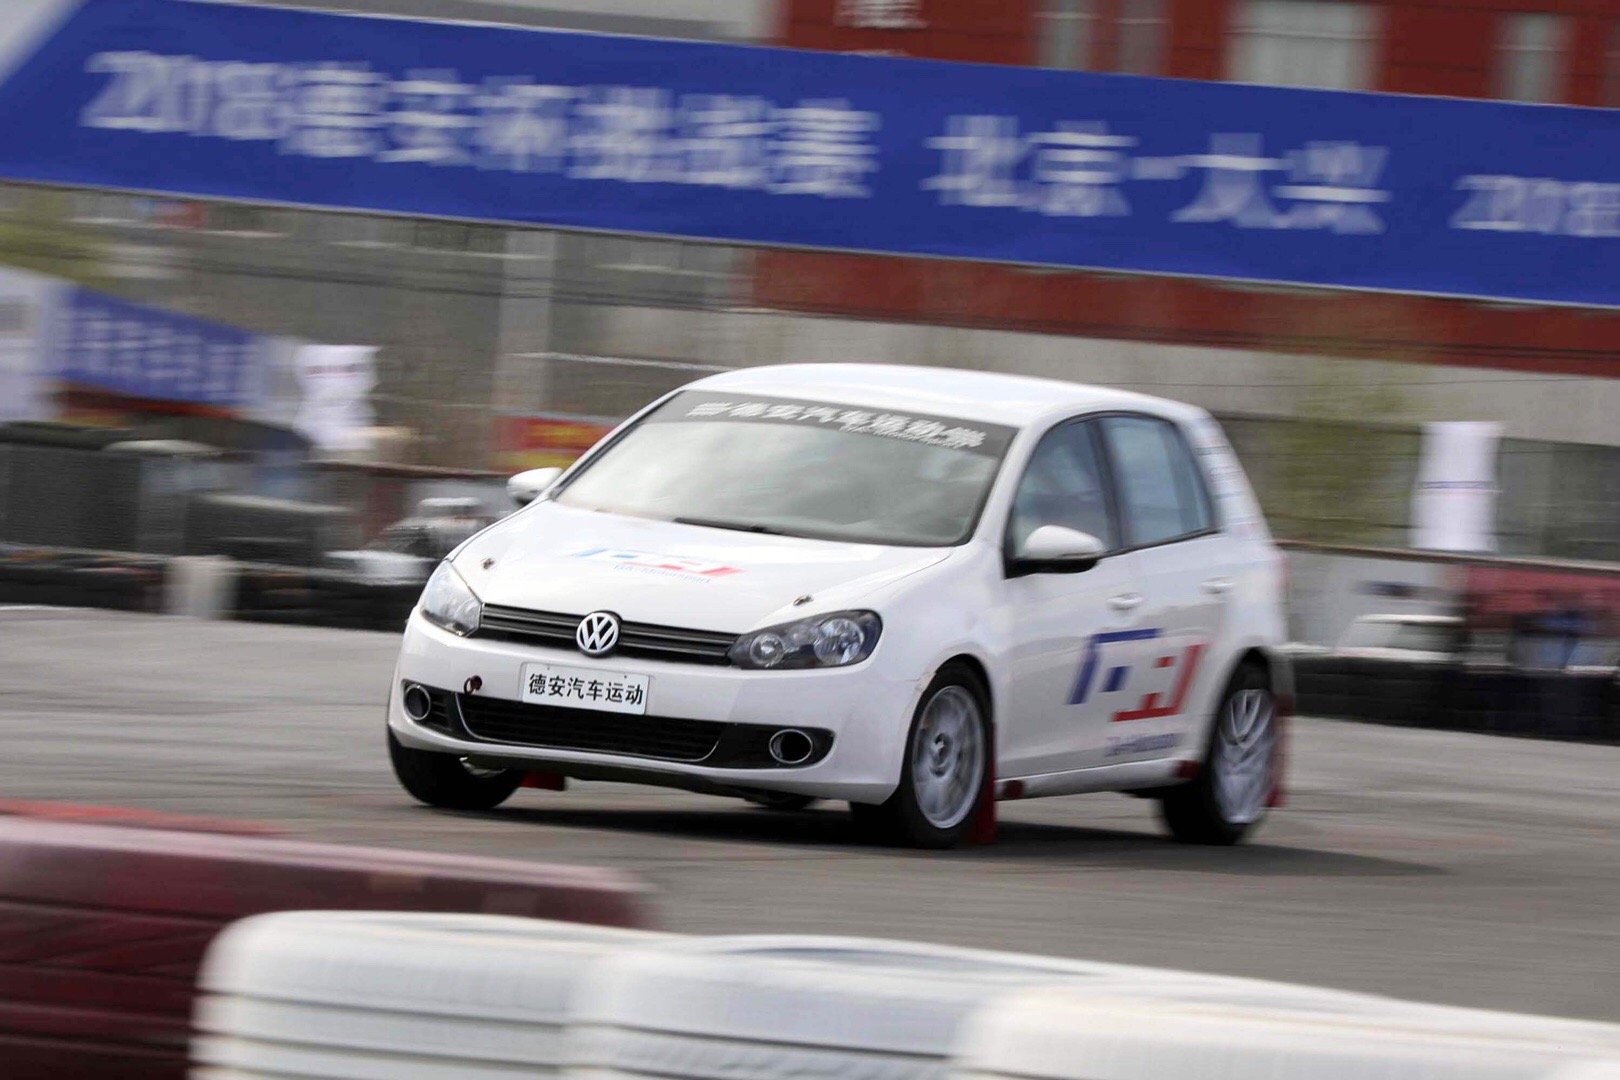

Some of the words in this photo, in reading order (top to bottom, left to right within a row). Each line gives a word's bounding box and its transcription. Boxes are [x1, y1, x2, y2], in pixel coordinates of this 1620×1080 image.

[529, 673, 643, 705] 德安汽车运动
